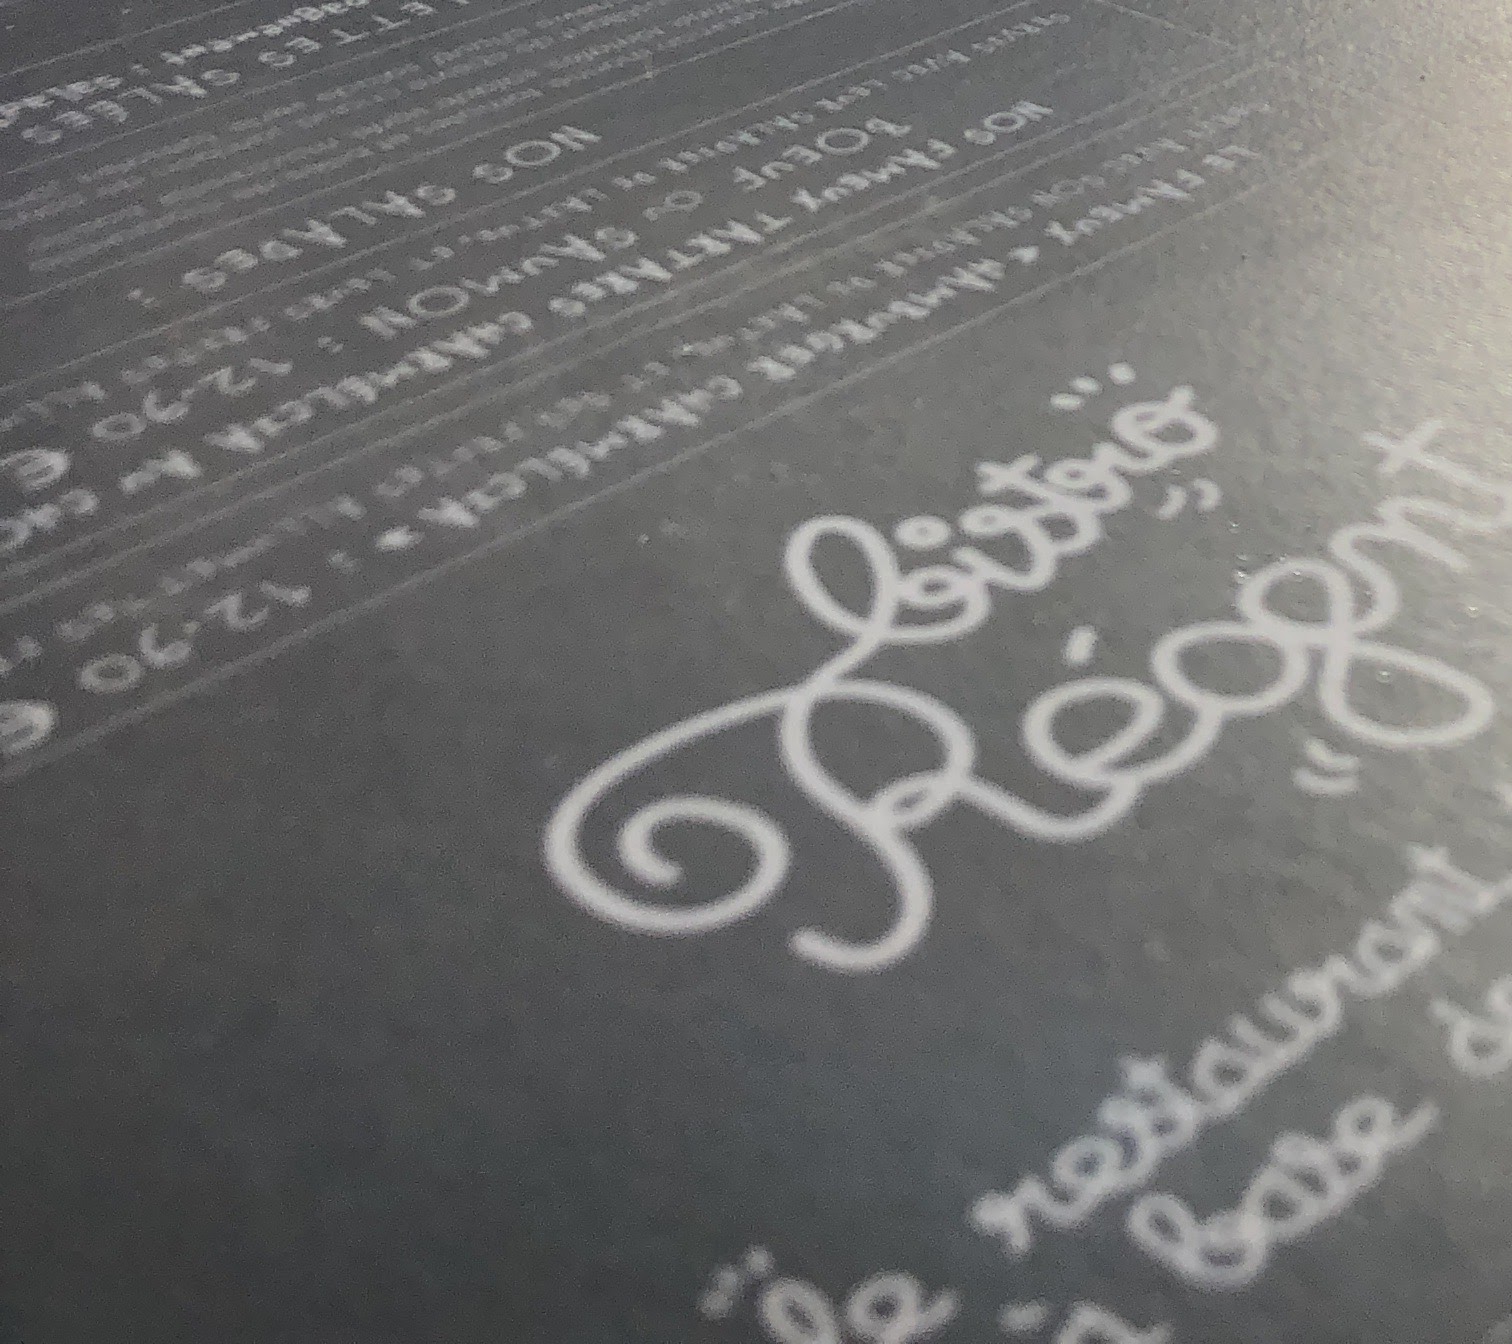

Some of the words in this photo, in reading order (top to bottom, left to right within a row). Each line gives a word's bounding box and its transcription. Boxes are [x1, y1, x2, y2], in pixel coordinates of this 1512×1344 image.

[473, 126, 599, 182] NOS
[734, 118, 910, 189] BOEUF
[964, 101, 1052, 144] NOS
[793, 139, 954, 210] FAMEUX
[1047, 169, 1204, 244] FAMEUX
[183, 185, 454, 290] SALADES
[361, 227, 635, 335] SAUMON
[550, 214, 789, 315] TARTARES
[91, 358, 291, 439] 12.90
[785, 368, 1218, 646] bistro
[80, 583, 309, 690] 12.90
[1131, 1098, 1434, 1290] base
